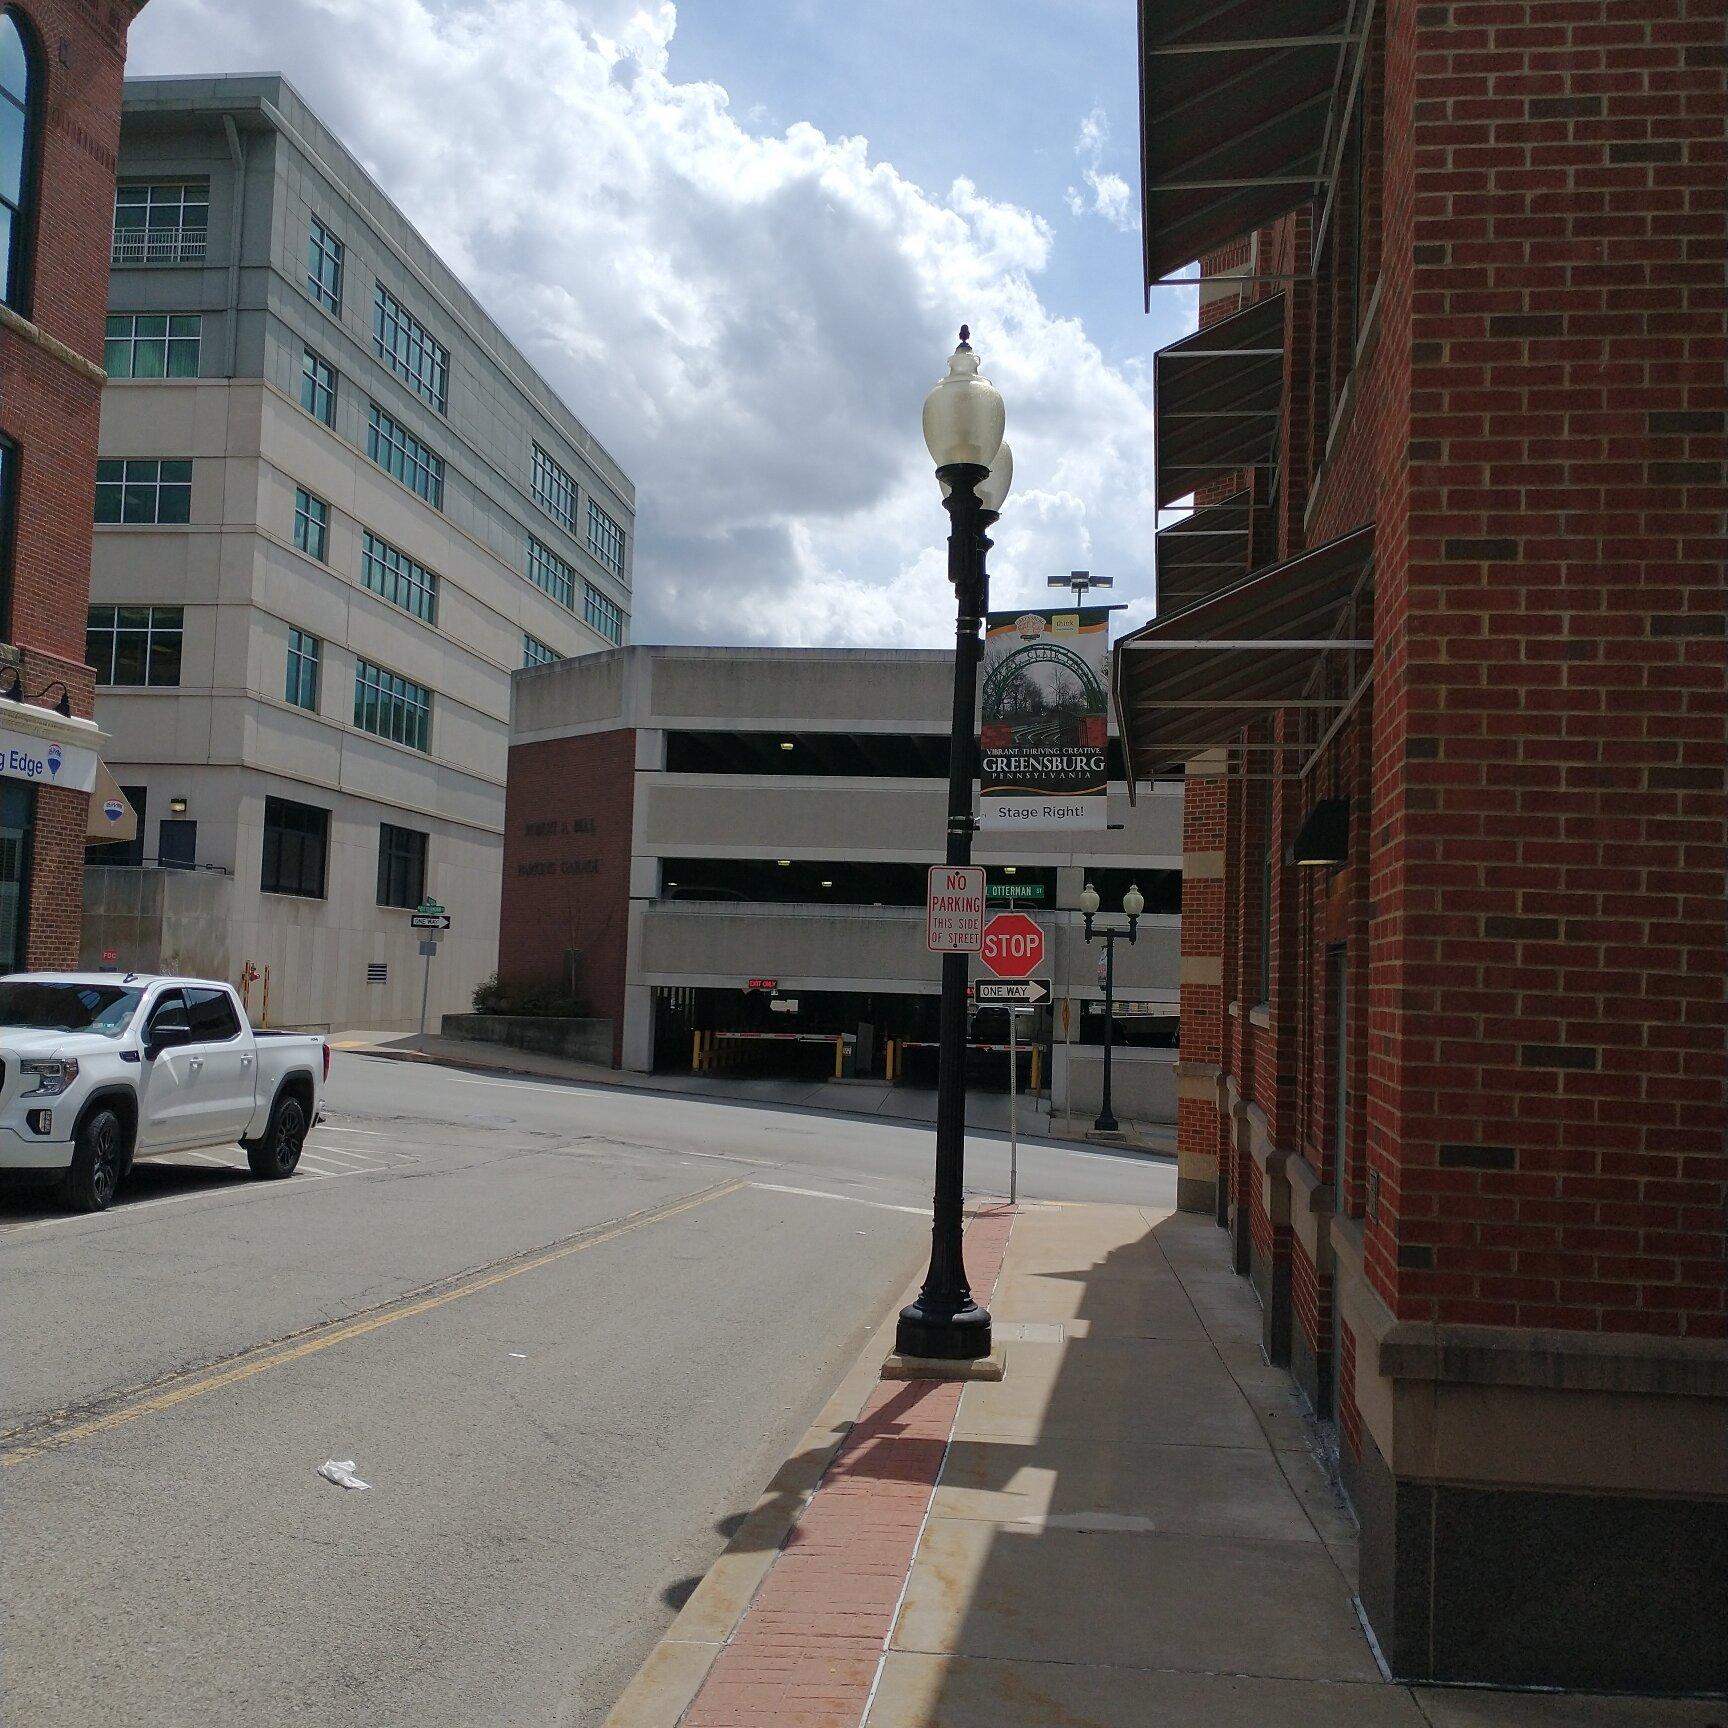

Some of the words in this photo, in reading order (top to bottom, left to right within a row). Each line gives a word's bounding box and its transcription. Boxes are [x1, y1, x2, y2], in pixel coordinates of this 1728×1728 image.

[10, 750, 43, 777] Edge
[982, 756, 1106, 772] GREENSBURG
[992, 772, 1091, 780] PENNSYLVANIA
[998, 807, 1038, 819] Stage
[1043, 806, 1084, 819] Right!
[946, 875, 967, 890] NO
[992, 886, 1031, 896] OTTERMAN
[932, 896, 980, 913] PARKING
[933, 918, 953, 929] THIS
[958, 919, 979, 930] SIDE
[932, 932, 942, 943] OF
[948, 932, 979, 944] STREET
[984, 934, 1040, 958] STOP
[982, 986, 1003, 997] ONE
[1006, 986, 1027, 997] WAY
